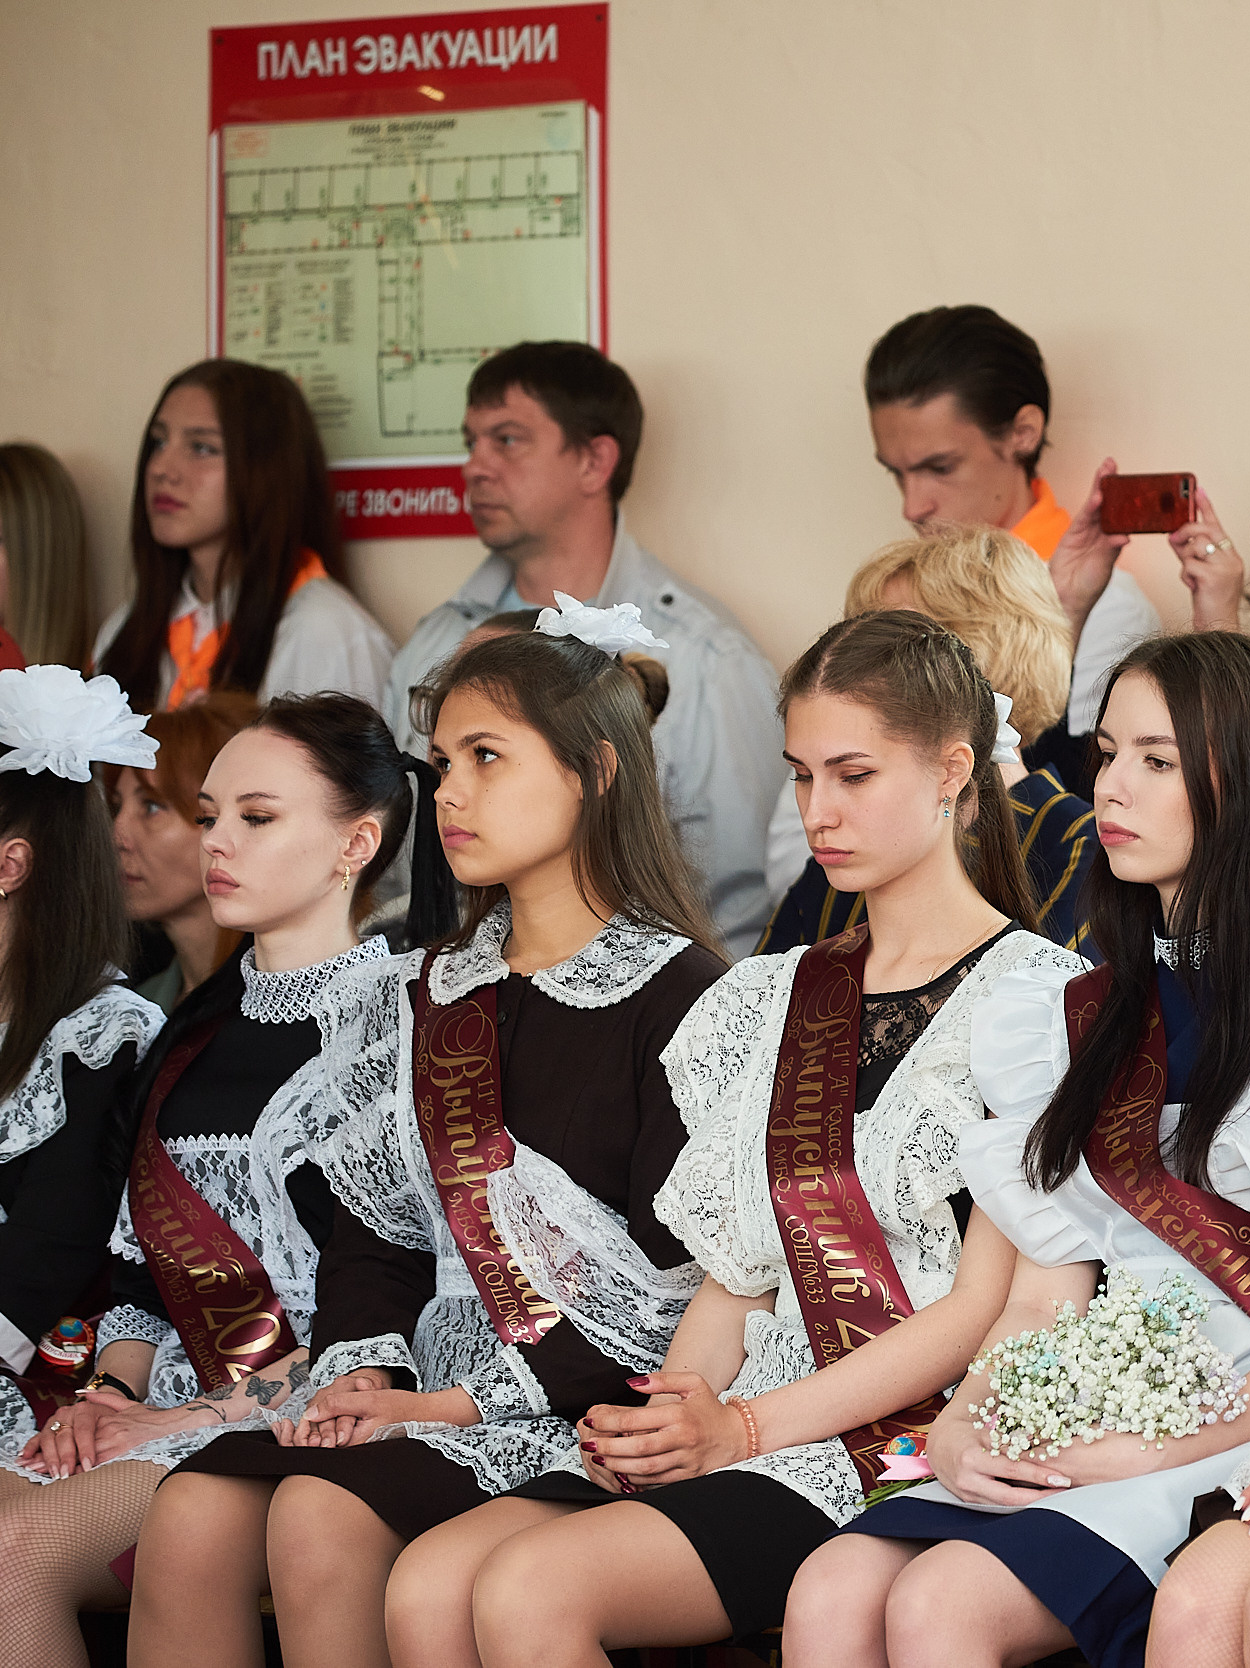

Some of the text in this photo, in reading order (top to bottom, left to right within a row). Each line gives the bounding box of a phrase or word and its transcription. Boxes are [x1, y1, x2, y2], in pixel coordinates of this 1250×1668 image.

[257, 24, 559, 80] ПЛАН ЭВАКУАЦИИ
[362, 487, 459, 517] ЗВОНИТЬ
[769, 963, 871, 1304] Выпускник
[447, 1191, 495, 1256] МБОУ
